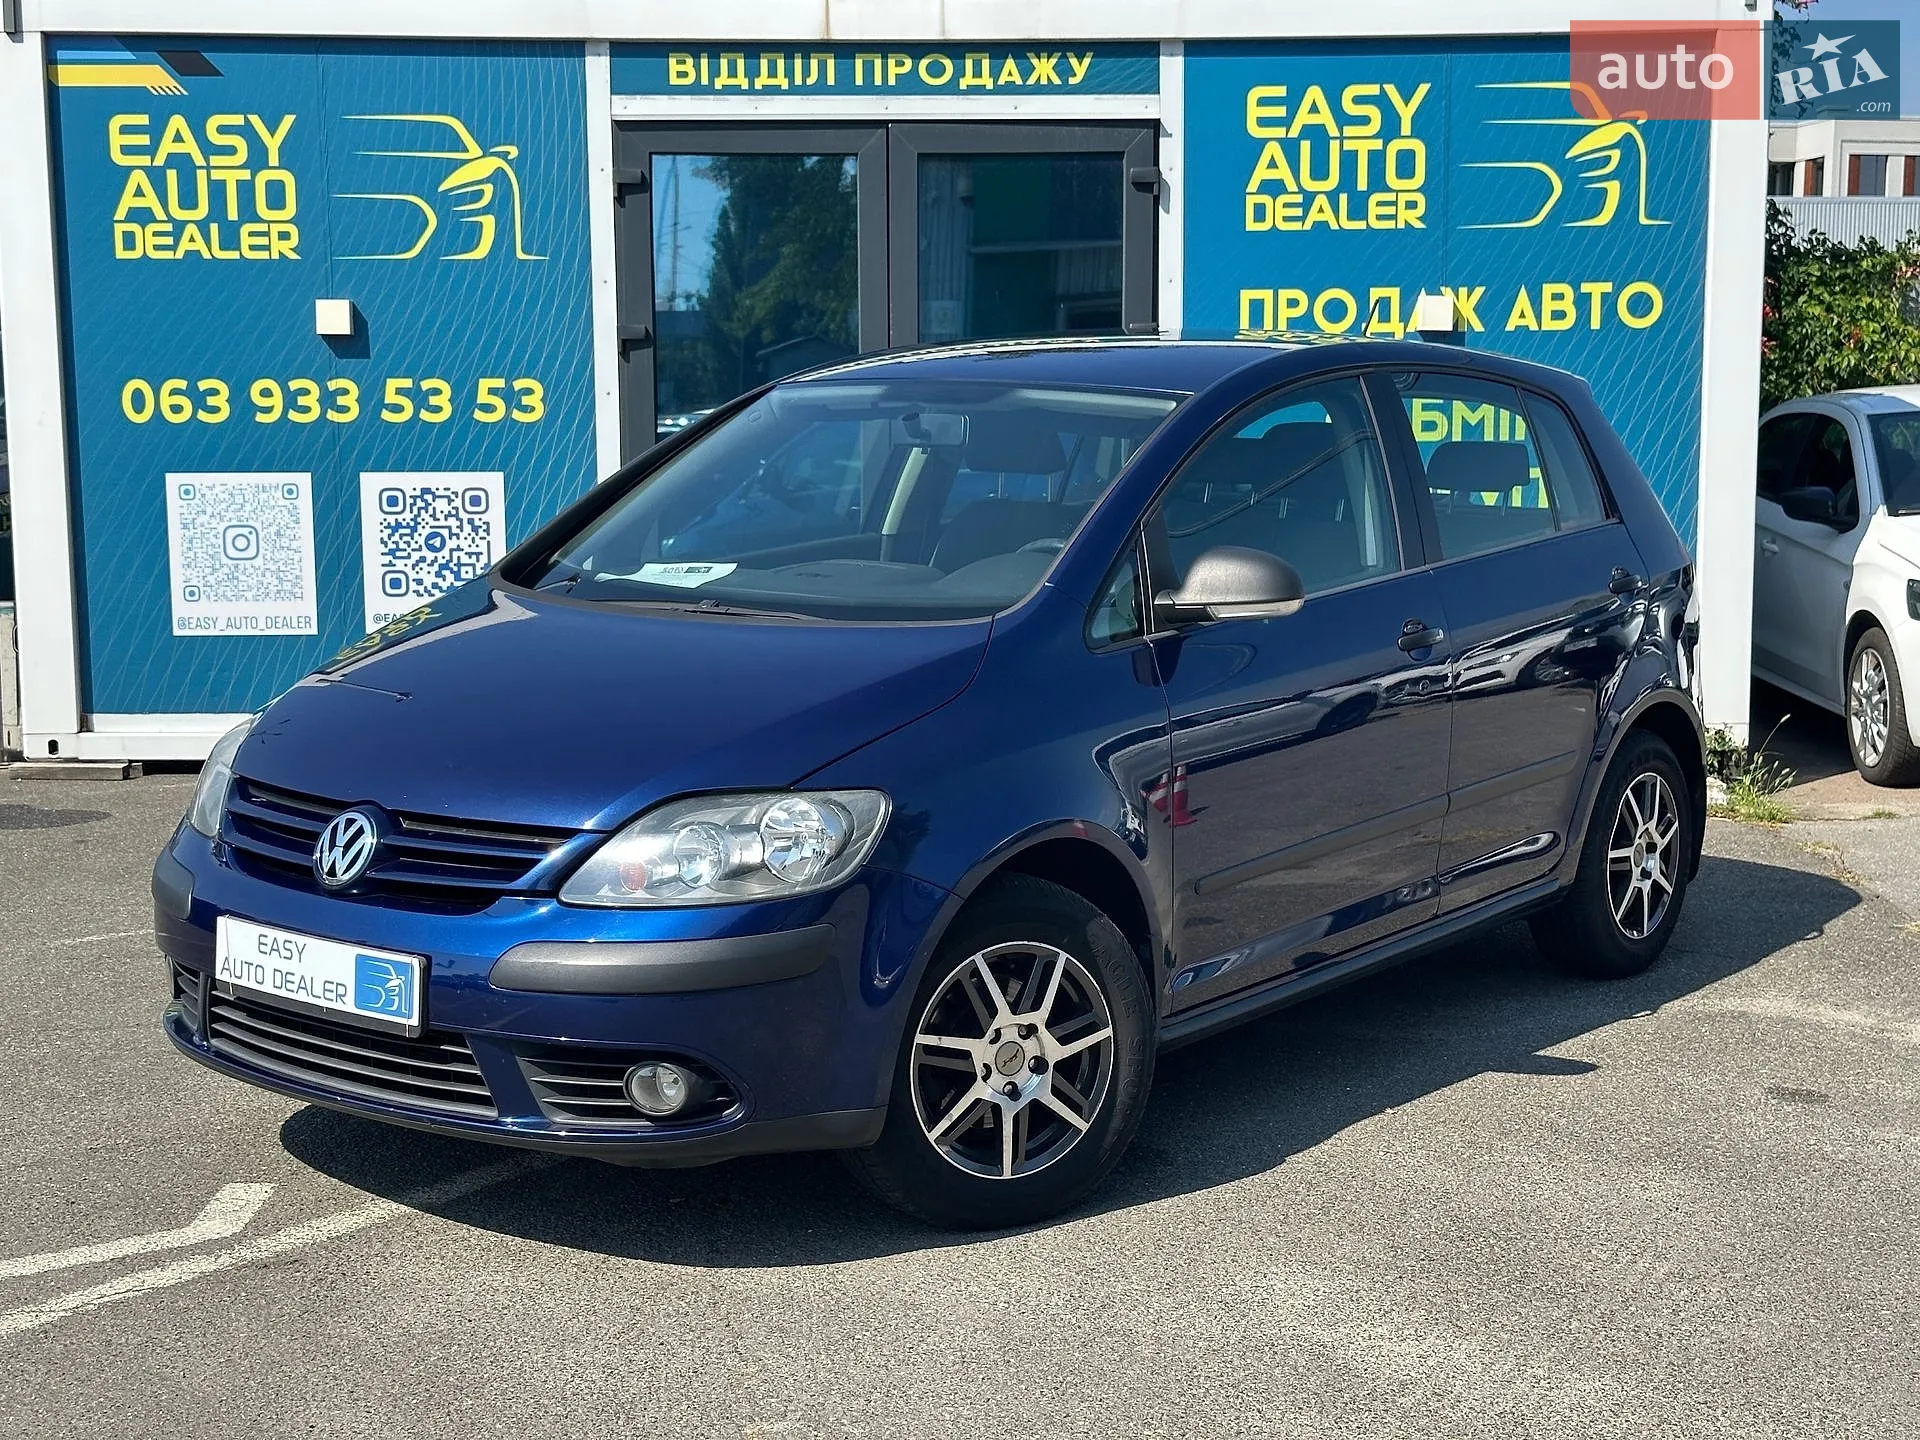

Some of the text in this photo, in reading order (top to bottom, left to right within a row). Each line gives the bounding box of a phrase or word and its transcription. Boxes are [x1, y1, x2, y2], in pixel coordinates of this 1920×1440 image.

[669, 52, 1094, 90] ВІДДІЛ ПРОДАЖУ
[1247, 82, 1431, 138] EASY
[108, 114, 296, 167] EASY
[1246, 139, 1427, 193] AUTO
[114, 169, 297, 221] AUTO
[1245, 192, 1426, 232] DEALER
[114, 223, 301, 259] DEALER
[1505, 281, 1664, 332] АВТО
[121, 377, 545, 424] 063 933 53 53
[177, 615, 312, 631] @EASY_AUTO_DEALER
[257, 932, 307, 964] EASY
[219, 956, 348, 1006] AUTO DEALER
